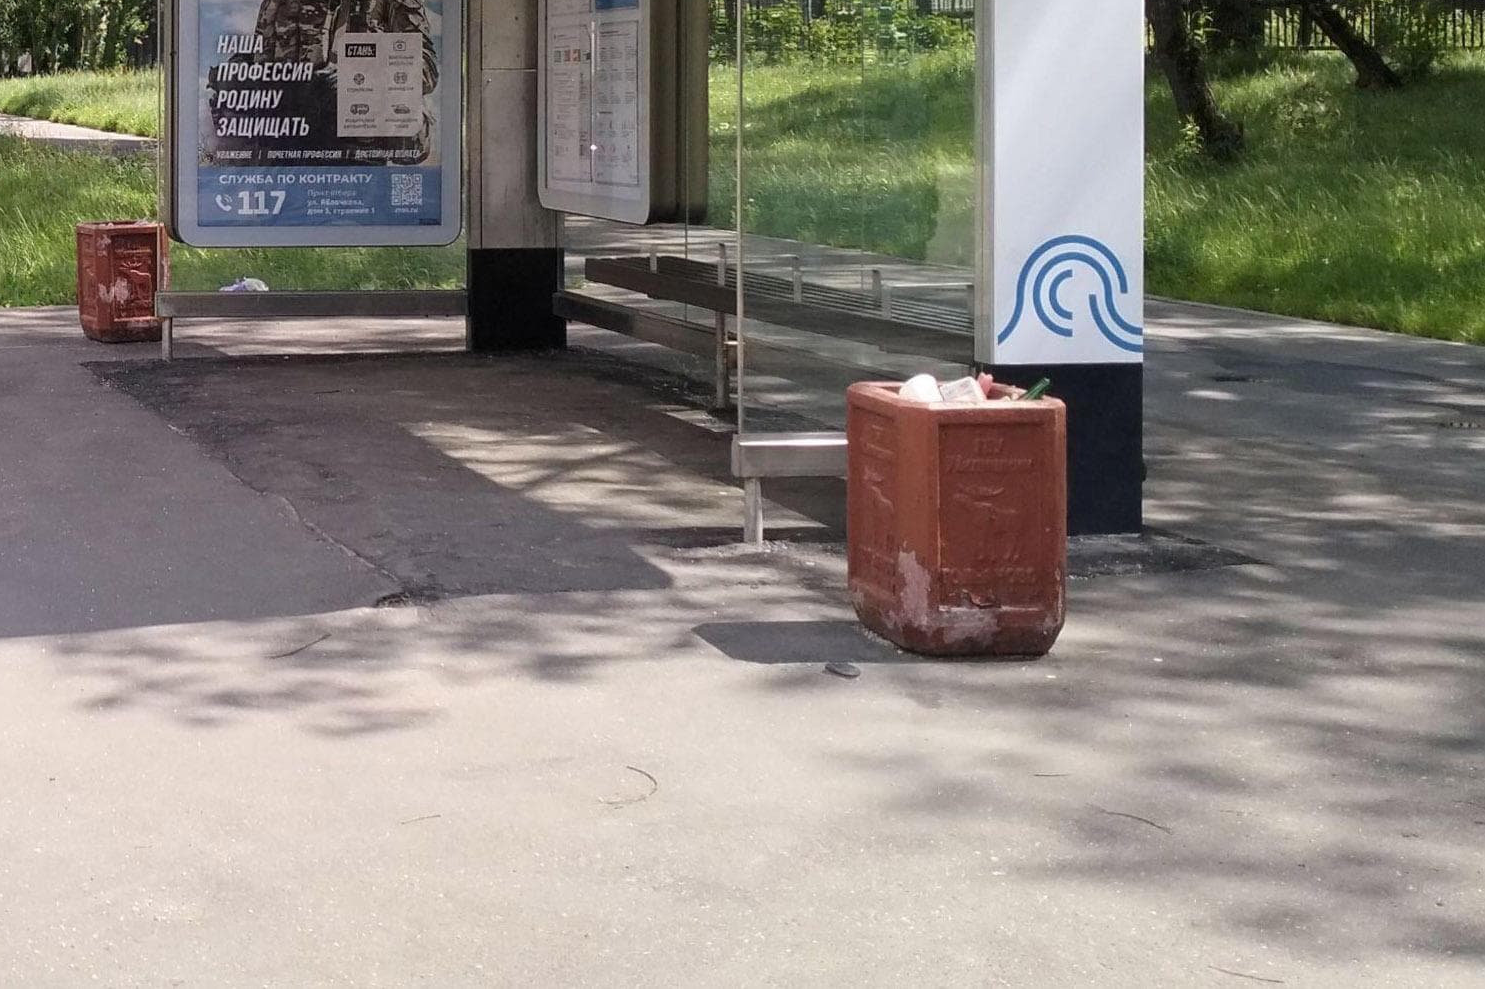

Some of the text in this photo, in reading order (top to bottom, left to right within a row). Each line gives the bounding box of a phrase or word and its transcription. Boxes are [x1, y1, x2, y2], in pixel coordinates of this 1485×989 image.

[217, 34, 264, 54] НАША
[347, 45, 375, 56] СТАНЬ:
[216, 61, 314, 82] ПРОФЕССИЯ
[216, 89, 283, 111] РОДИНУ
[216, 117, 310, 138] ЗАЩИЩАТЬ
[216, 150, 253, 159] УВАЖЕНИЕ
[302, 150, 343, 159] ПРОФЕССИЯ
[218, 173, 373, 184] СЛУЖБА ПО КОНТРАКТУ
[237, 190, 286, 215] 117
